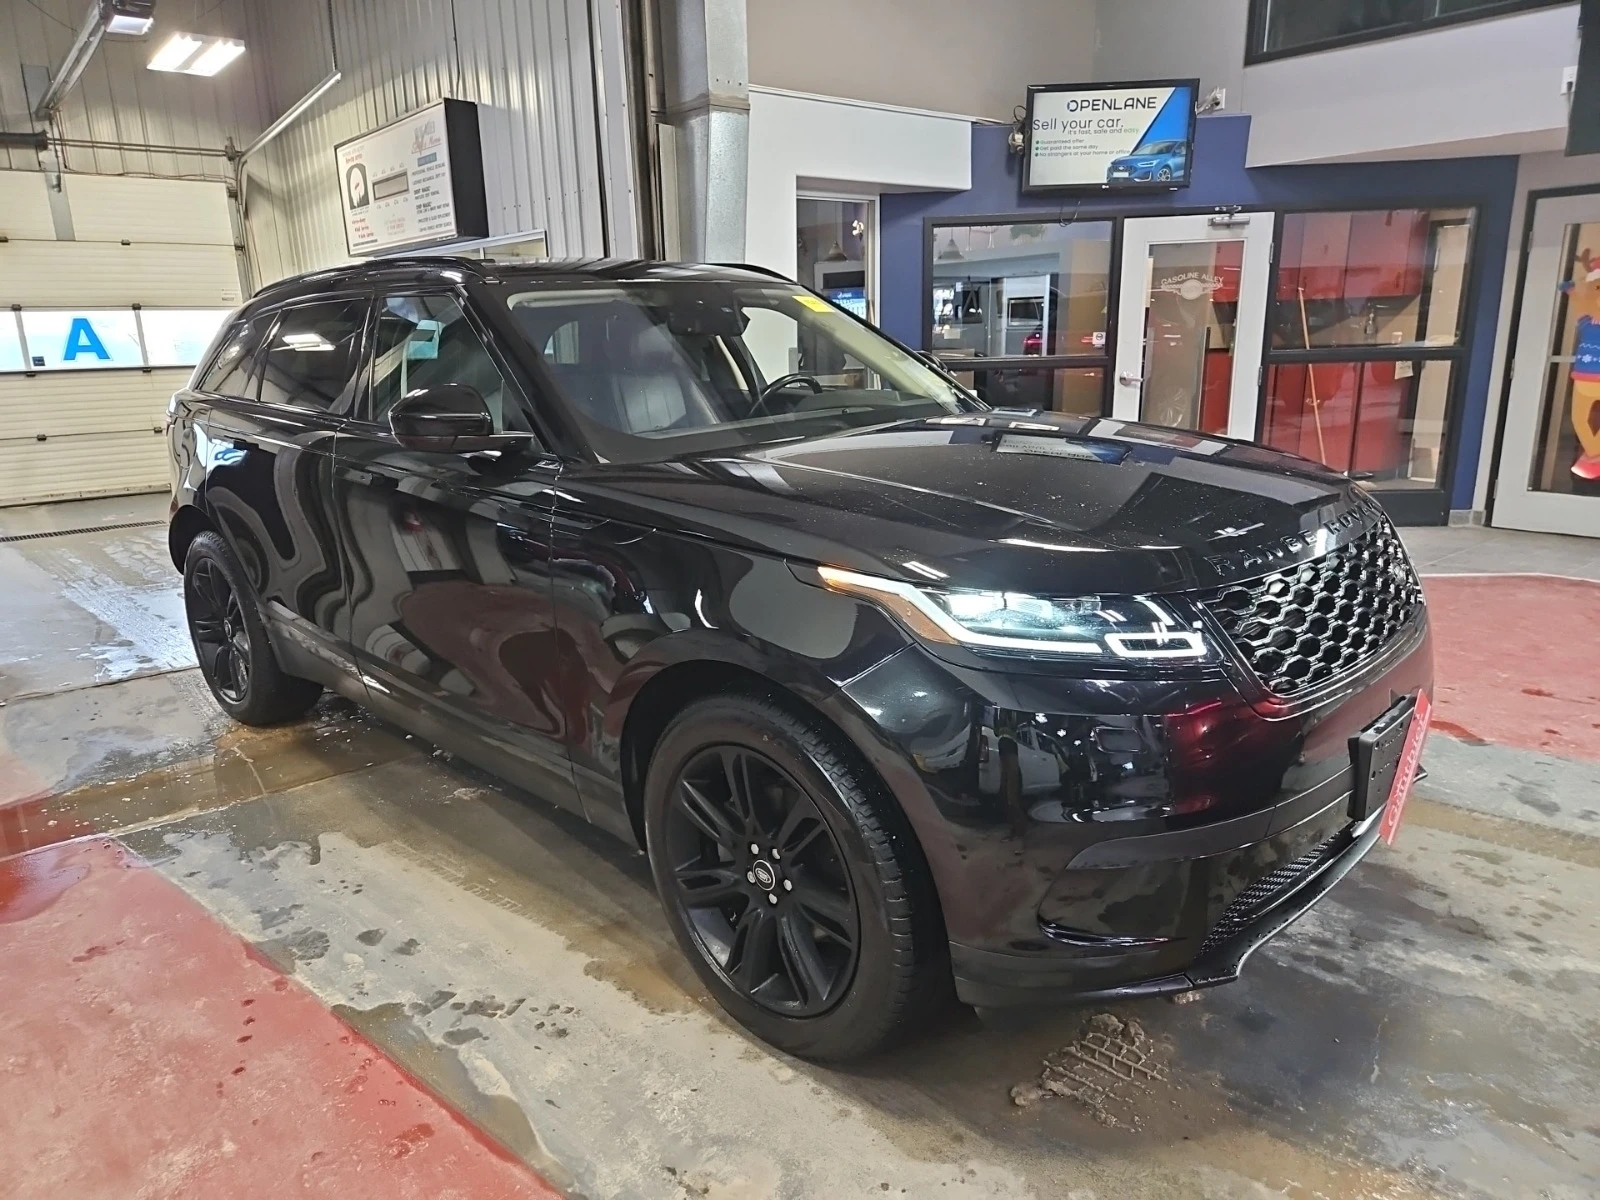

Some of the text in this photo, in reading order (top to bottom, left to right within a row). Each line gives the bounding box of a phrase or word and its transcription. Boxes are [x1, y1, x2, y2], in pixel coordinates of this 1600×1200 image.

[1067, 97, 1157, 112] OPENLANE
[1033, 118, 1124, 133] Sell your car.
[1161, 272, 1224, 285] GASOLINE ALLEY
[63, 318, 111, 361] A
[1203, 530, 1317, 576] RANGE
